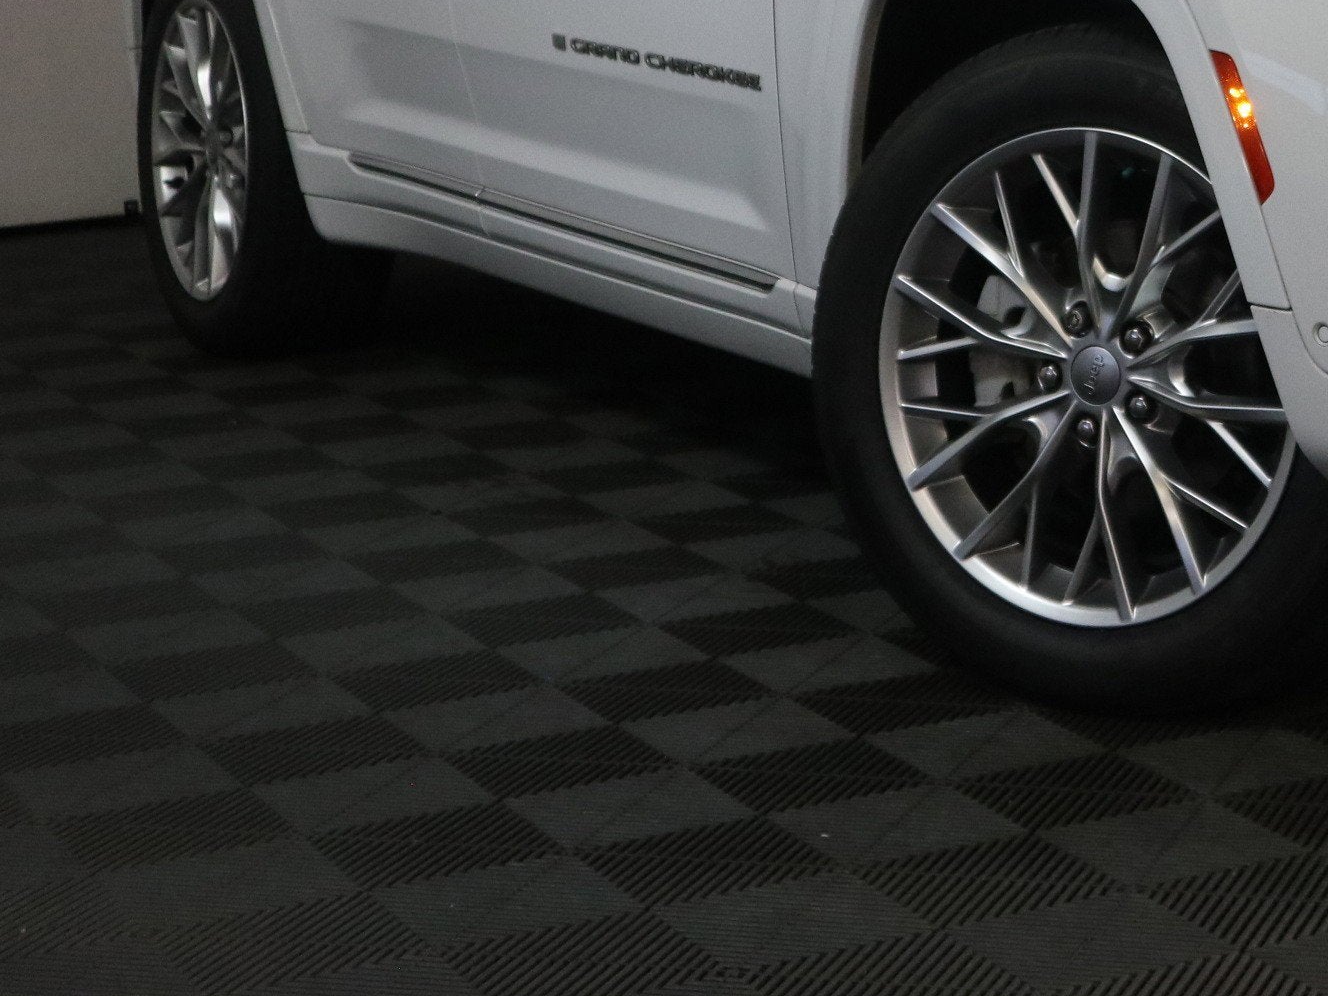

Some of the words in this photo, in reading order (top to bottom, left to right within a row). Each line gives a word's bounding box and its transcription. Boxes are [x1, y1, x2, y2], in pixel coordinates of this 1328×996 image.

[570, 37, 640, 65] GRAND
[644, 52, 762, 92] CHEROKEE
[1082, 354, 1106, 396] Jeep
